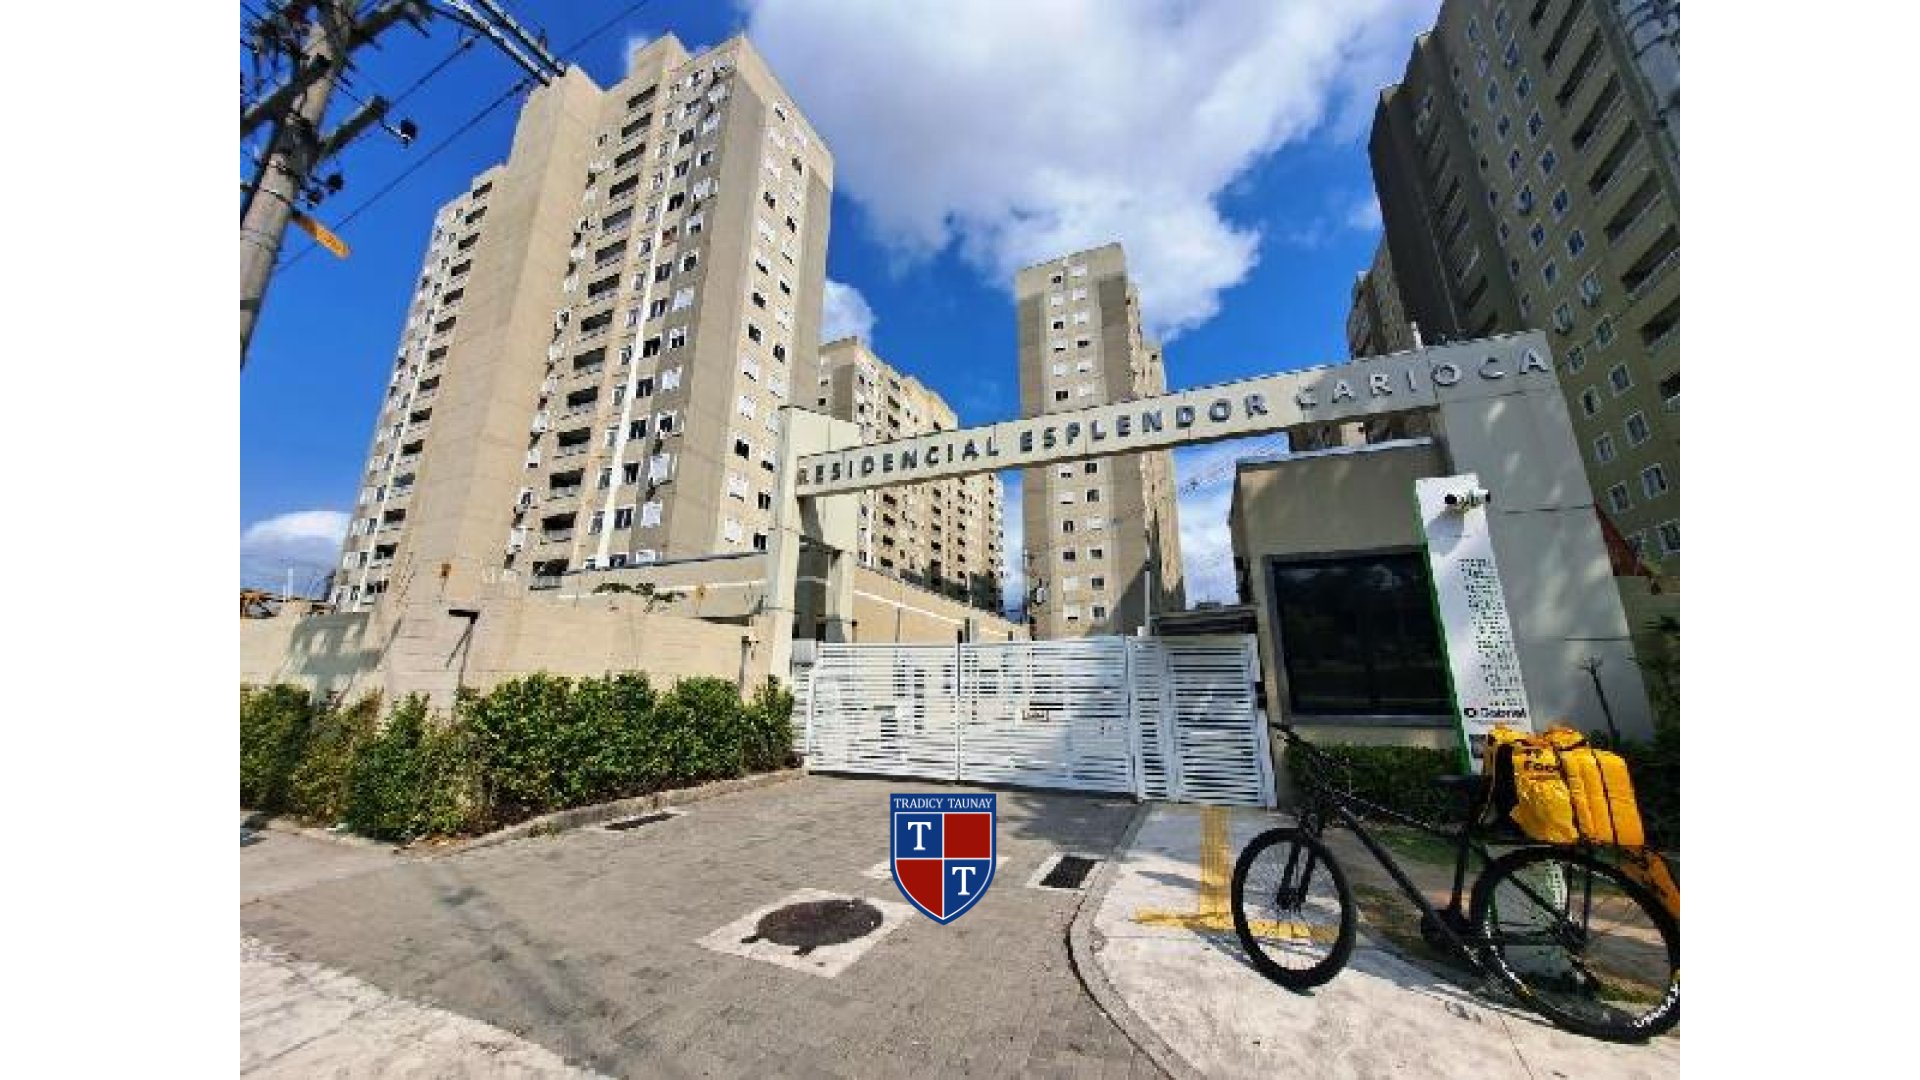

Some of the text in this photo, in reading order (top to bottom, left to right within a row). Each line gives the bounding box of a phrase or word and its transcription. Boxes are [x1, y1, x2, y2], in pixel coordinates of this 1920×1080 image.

[797, 347, 1549, 485] RESIDENCIAL ESPLENDOR CARIOCA
